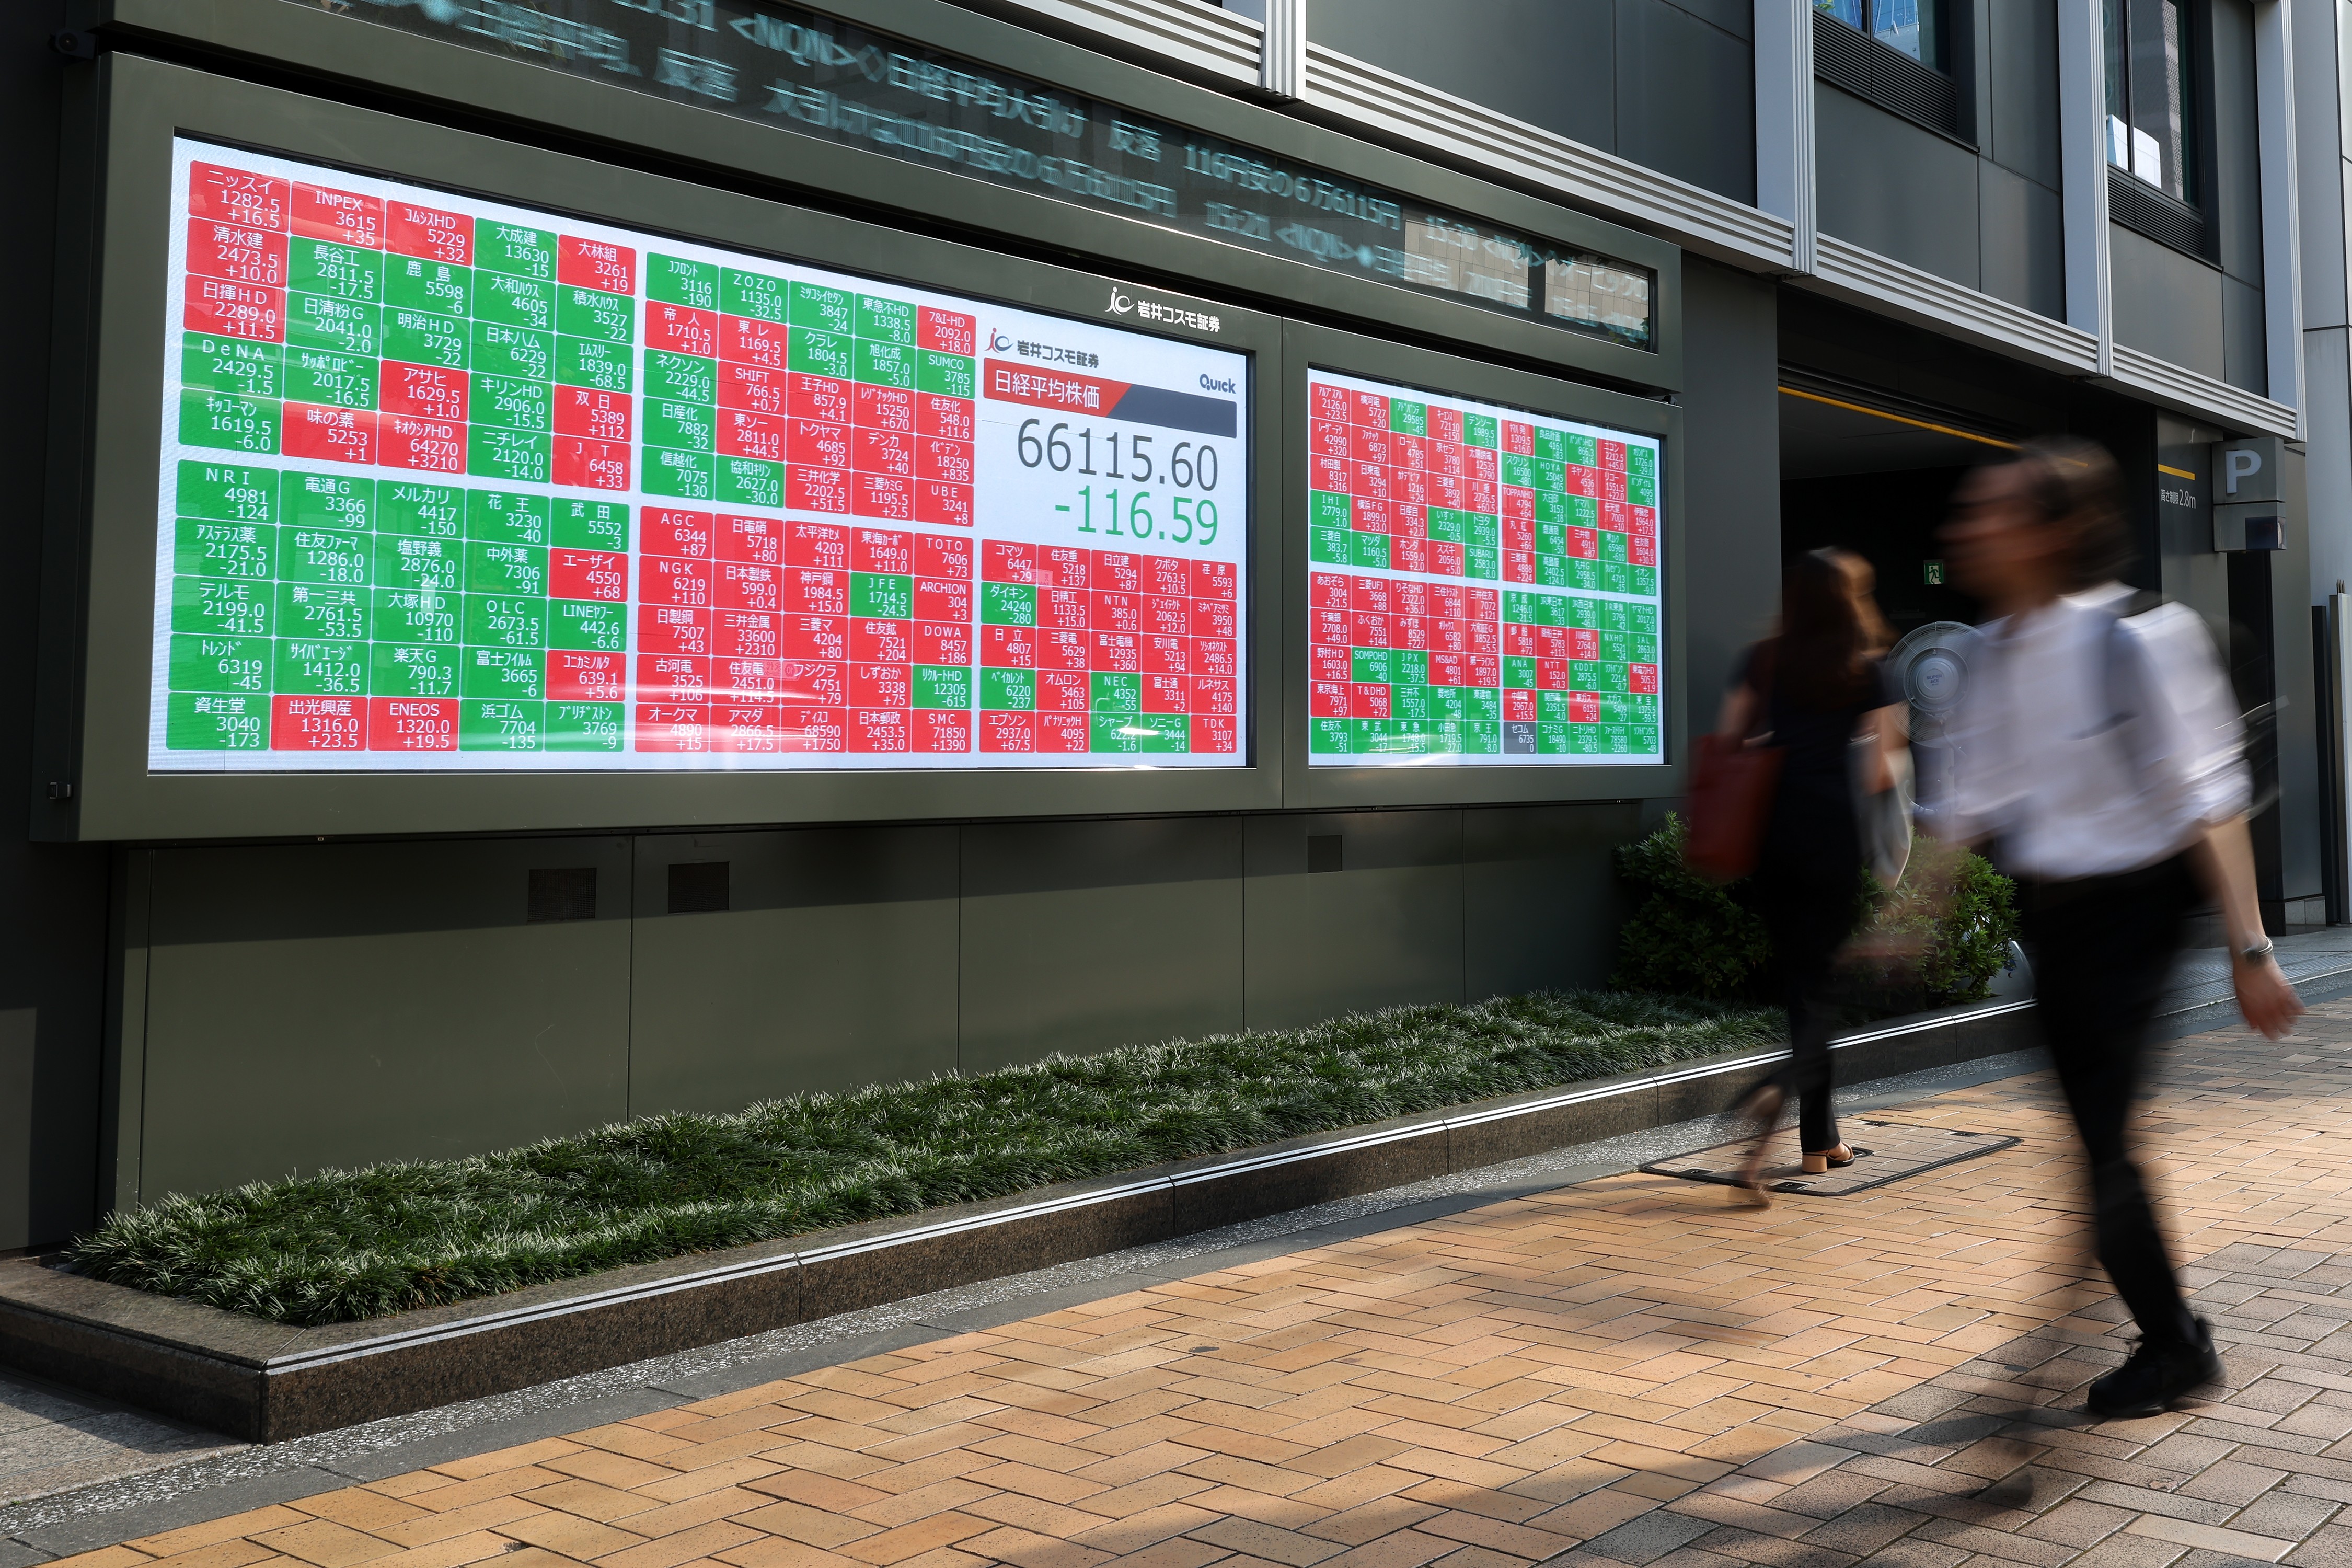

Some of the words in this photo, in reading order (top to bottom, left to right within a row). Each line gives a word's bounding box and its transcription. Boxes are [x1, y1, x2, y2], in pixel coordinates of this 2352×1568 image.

[207, 170, 274, 194] ニッスイ
[221, 189, 280, 213] 1282.5
[315, 190, 363, 212] INPEX
[227, 209, 279, 228] +16.5
[336, 211, 376, 231] 3615
[342, 229, 375, 246] +35
[495, 225, 537, 247] 大成建
[313, 244, 360, 267] 長谷工
[505, 244, 549, 264] 13630
[317, 262, 374, 285] 2811.5
[525, 263, 549, 278] -15
[330, 281, 373, 299] -17.5
[862, 297, 909, 317] 東急不HD
[874, 314, 911, 331] 1338.5
[1137, 300, 1220, 333] 岩井コスモ証券
[487, 327, 540, 349] 日本ハム
[889, 329, 910, 343] -8.0
[935, 325, 971, 342] 2092.0
[939, 340, 971, 354] +18.0
[510, 347, 546, 364] 6229
[1017, 340, 1099, 368] 岩井コスモ証券
[656, 353, 705, 373] ネクソン
[929, 354, 964, 370] SUMCO
[403, 367, 446, 387] アサヒ
[522, 363, 546, 379] -22
[944, 370, 970, 385] 3785
[665, 371, 710, 389] 2229.0
[801, 376, 839, 394] 王子HD
[408, 385, 460, 404] 1629.5
[676, 387, 710, 402] -44.5
[946, 383, 970, 396] -115
[995, 370, 1100, 410] 日経平均株価
[814, 393, 846, 409] 857.9
[423, 403, 459, 418] +1.0
[819, 408, 846, 421] +4.1
[1369, 407, 1387, 419] 5727
[307, 408, 354, 429] 味の素
[1371, 418, 1386, 428] +20
[328, 428, 367, 446] 5253
[1399, 436, 1419, 448] ローム
[345, 447, 367, 462] +1
[1018, 418, 1218, 491] 66115.60
[1406, 448, 1424, 459] 4785
[1410, 459, 1424, 469] +51
[1540, 462, 1561, 472] HOYA
[797, 468, 840, 485] 三井化学
[1329, 470, 1347, 482] 8317
[1545, 471, 1563, 482] 25045
[2226, 449, 2262, 493] P
[305, 476, 350, 494] 電通G
[805, 483, 845, 499] 2202.5
[1328, 481, 1347, 492] +316
[1550, 482, 1564, 491] -405
[325, 496, 365, 513] 3366
[810, 498, 845, 512] +51.5
[1400, 504, 1419, 517] 日産自
[338, 513, 365, 528] -99
[1055, 485, 1218, 545] -116.59
[1405, 516, 1424, 528] 334.3
[1408, 527, 1424, 537] +2.0
[1361, 535, 1381, 546] マツダ
[487, 547, 528, 564] 中外薬
[1051, 549, 1078, 562] 住友重
[1363, 546, 1387, 558] 1160.5
[1063, 563, 1086, 575] 5218
[1154, 558, 1179, 571] クボタ
[1373, 557, 1387, 568] -5.0
[504, 564, 540, 580] 7306
[726, 566, 772, 582] 日本製鉄
[1156, 571, 1186, 584] 2763.5
[1634, 567, 1650, 577] イオン
[516, 580, 539, 594] -91
[1060, 575, 1086, 586] +137
[1358, 579, 1383, 590] 三菱UFJ
[1636, 577, 1654, 587] 1357.5
[199, 583, 250, 600] テルモ
[742, 582, 776, 596] 599.0
[920, 581, 966, 595] ARCHION
[1160, 583, 1186, 595] +10.5
[1643, 586, 1654, 595] -9.0
[747, 596, 776, 609] +0.4
[948, 596, 967, 608] 304
[1369, 591, 1387, 602] 3668
[203, 600, 264, 618] 2199.0
[1372, 601, 1387, 612] +88
[1480, 601, 1496, 611] 7072
[952, 609, 967, 620] +3
[1320, 611, 1342, 622] 千葉銀
[1480, 610, 1496, 620] +121
[217, 617, 264, 633] -41.5
[1322, 622, 1347, 634] 2708.0
[1099, 633, 1133, 647] 富士電機
[1325, 633, 1347, 644] +49.0
[1551, 639, 1565, 649] 5783
[1109, 648, 1137, 660] 12935
[1354, 650, 1388, 661] SOMPOHD
[1435, 654, 1458, 664] MS&AD
[1550, 648, 1566, 657] +113
[1113, 659, 1137, 671] +360
[1369, 661, 1387, 672] 6906
[1445, 665, 1461, 675] 4801
[1545, 661, 1560, 670] NTT
[1375, 672, 1387, 682] -40
[1448, 675, 1461, 685] +61
[1549, 671, 1565, 680] 152.0
[1197, 678, 1229, 690] ルネサス
[1317, 683, 1345, 695] 東京海上
[1551, 679, 1566, 689] +0.3
[1212, 691, 1232, 702] 4175
[1329, 696, 1347, 706] 7971
[194, 696, 246, 714] 資生堂
[390, 702, 440, 716] ENEOS
[1210, 702, 1233, 713] +140
[1332, 706, 1348, 716] +97
[216, 716, 260, 731] 3040
[859, 711, 901, 725] 日本郵政
[989, 713, 1027, 726] エプソン
[397, 719, 450, 733] 1320.0
[867, 726, 905, 738] 2453.5
[1320, 720, 1342, 731] 住友不
[1511, 724, 1529, 734] セコム
[1542, 724, 1563, 734] コナミG
[219, 732, 260, 747] -173
[996, 727, 1030, 739] 2937.0
[1330, 732, 1348, 742] 3793
[1518, 734, 1534, 743] 6735
[1548, 735, 1566, 744] 18490
[403, 734, 449, 748] +19.5
[872, 739, 905, 751] +35.0
[1000, 739, 1030, 751] +67.5
[1335, 742, 1347, 752] -51
[1529, 743, 1534, 753] 0
[1556, 744, 1566, 753] -10
